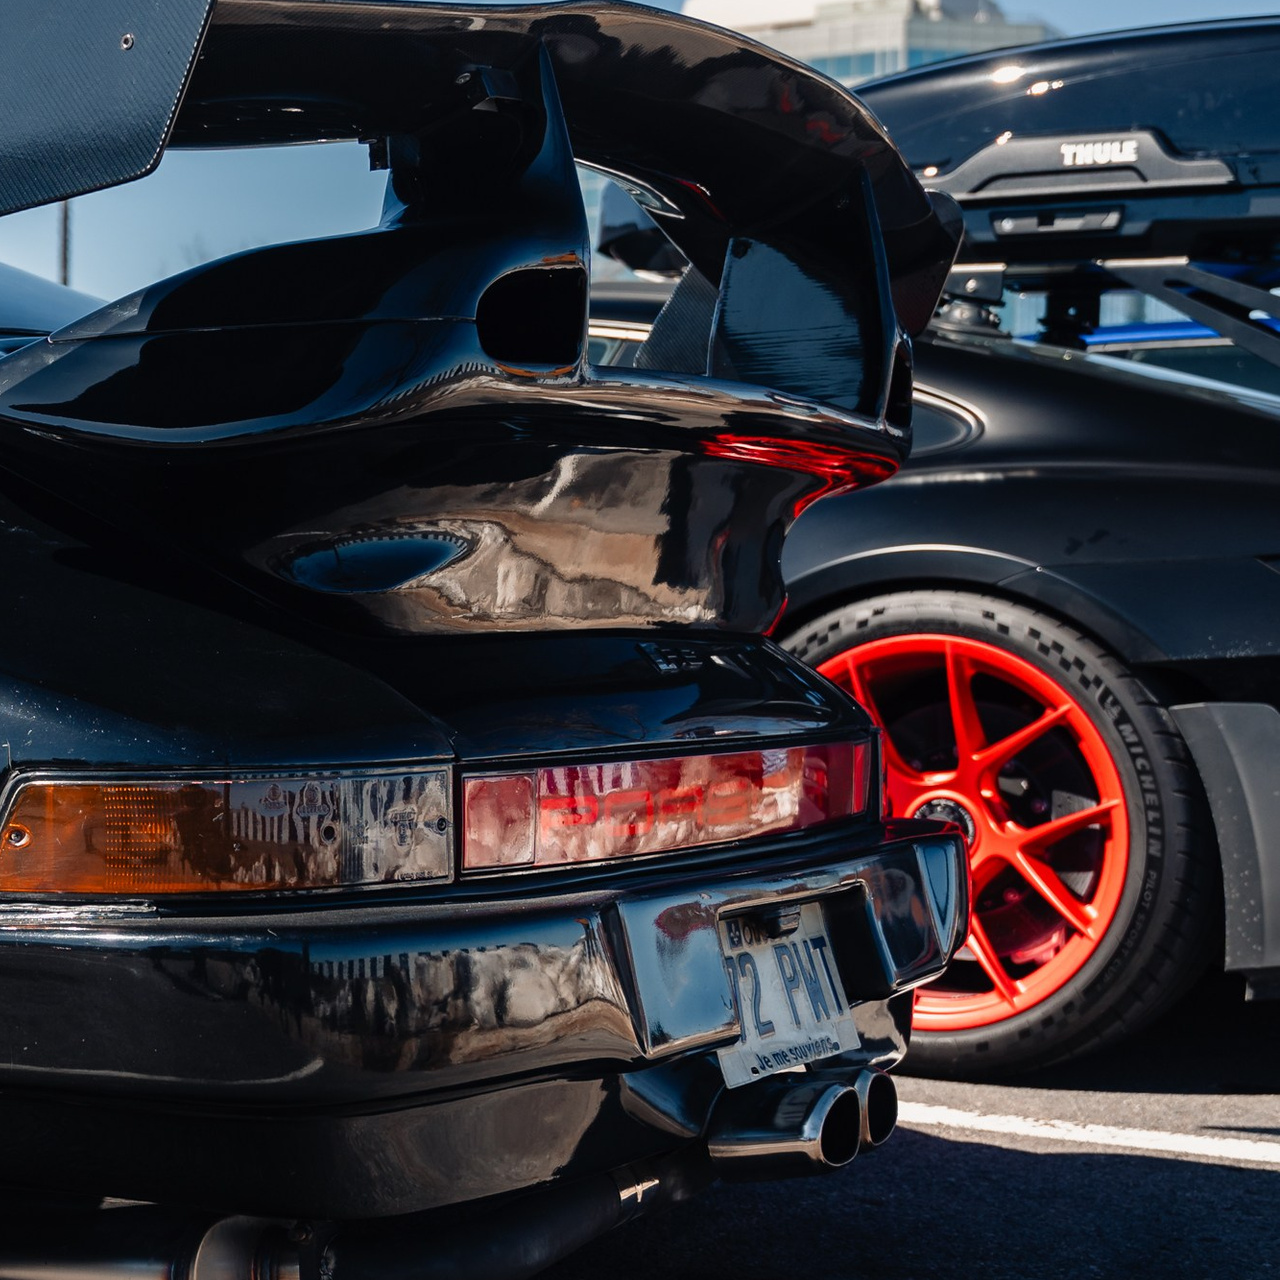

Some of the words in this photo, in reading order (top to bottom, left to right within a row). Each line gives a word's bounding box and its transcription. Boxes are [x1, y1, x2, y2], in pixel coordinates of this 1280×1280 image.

[1060, 140, 1138, 166] THULE
[1118, 722, 1162, 858] MICHELIN
[1141, 870, 1157, 910] PILOT
[773, 936, 844, 1029] PWT
[756, 1053, 773, 1071] Je
[772, 1047, 790, 1066] me
[789, 1036, 833, 1060] souviens
